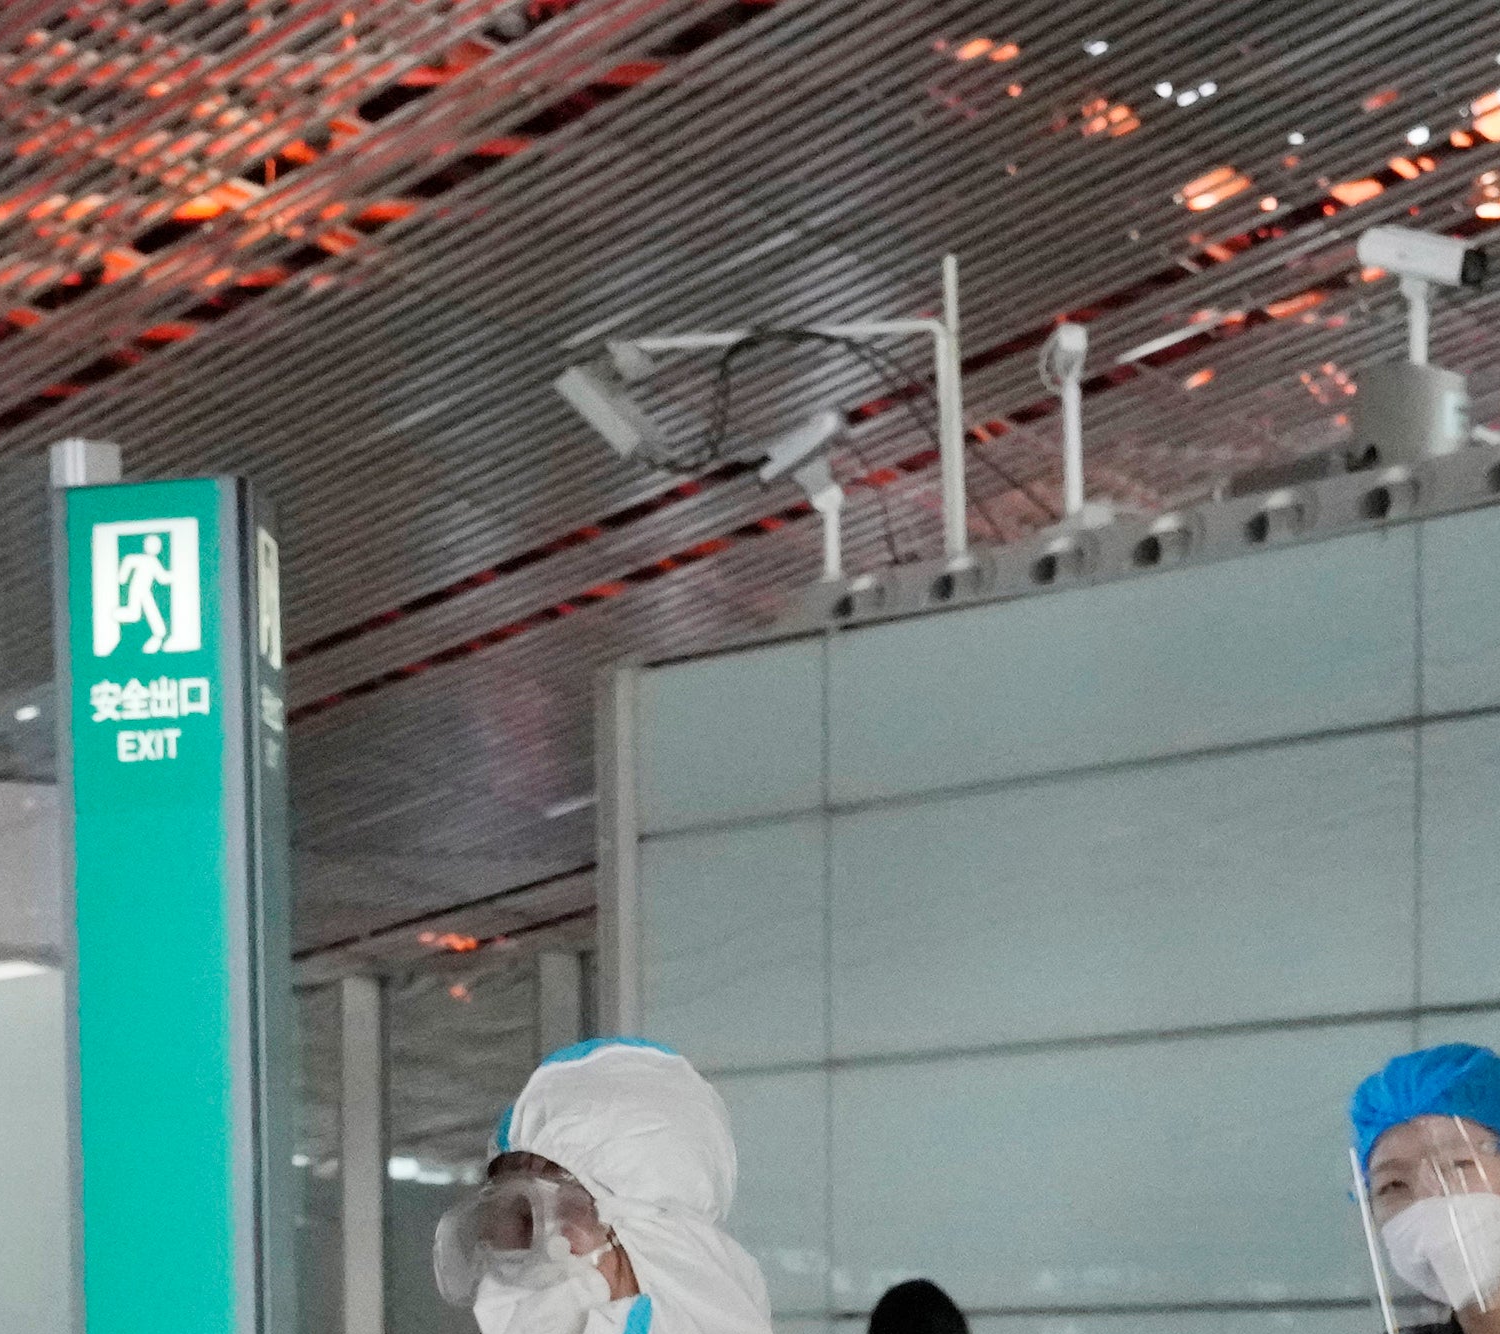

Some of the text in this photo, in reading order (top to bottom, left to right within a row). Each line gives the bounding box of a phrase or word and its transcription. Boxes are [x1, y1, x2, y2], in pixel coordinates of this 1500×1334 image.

[89, 676, 211, 722] 安全出口
[116, 728, 182, 762] EXIT
